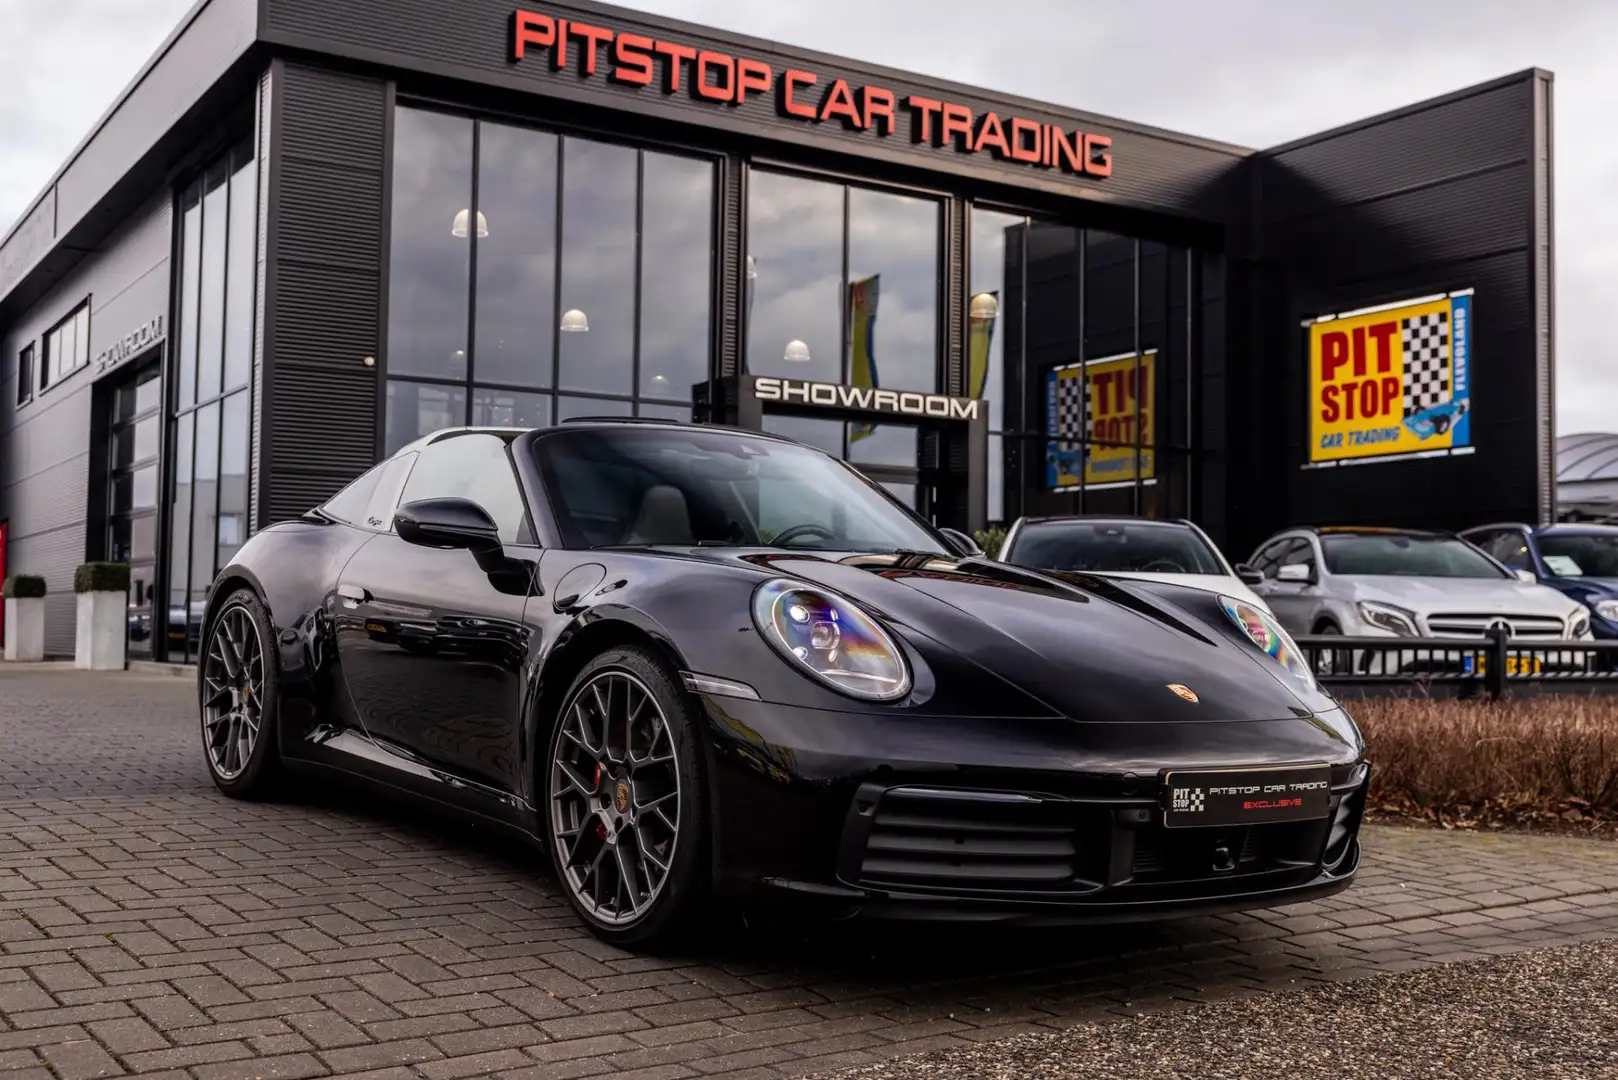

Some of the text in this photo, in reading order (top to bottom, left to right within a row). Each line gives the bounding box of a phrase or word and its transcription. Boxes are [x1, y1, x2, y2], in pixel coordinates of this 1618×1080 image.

[514, 9, 1113, 178] PITSTOP CAR TRADING
[1320, 320, 1399, 382] PIT
[754, 377, 979, 420] SHOWROOM
[1320, 377, 1400, 424] STOP
[1320, 426, 1401, 450] CAR TRADING
[1172, 788, 1190, 800] PIT
[1209, 780, 1328, 796] PITSTOP CAR TRADING
[1172, 799, 1190, 809] STOP
[1243, 797, 1303, 810] EXCLUSIVE
